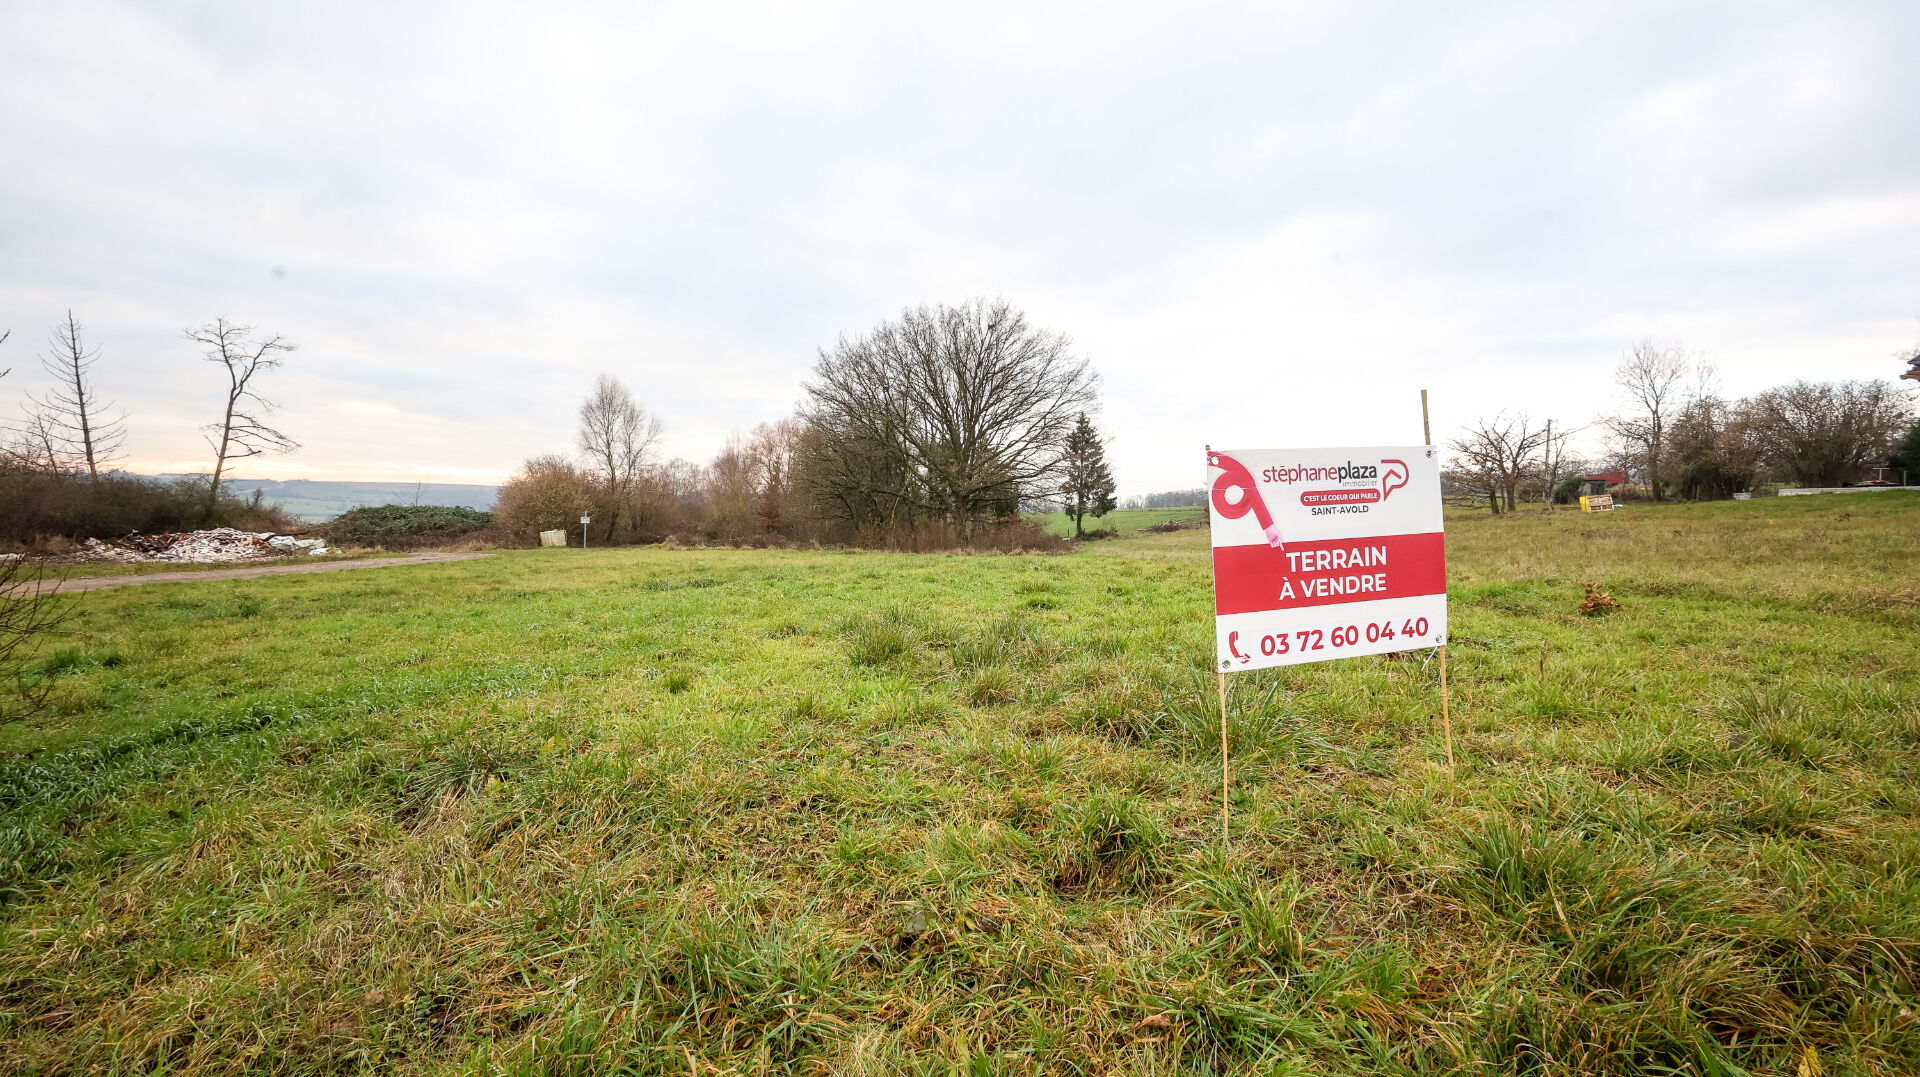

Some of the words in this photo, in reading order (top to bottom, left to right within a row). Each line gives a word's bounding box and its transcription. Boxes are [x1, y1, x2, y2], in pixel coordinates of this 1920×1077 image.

[1311, 505, 1369, 515] SAINT-AVOLD
[1286, 546, 1387, 573] TERRAIN
[1279, 577, 1296, 600] À
[1300, 573, 1387, 598] VENDRE
[1260, 633, 1290, 656] 03
[1297, 629, 1324, 652] 72
[1331, 625, 1359, 648] 60
[1366, 621, 1395, 643] 04
[1401, 617, 1429, 638] 40
